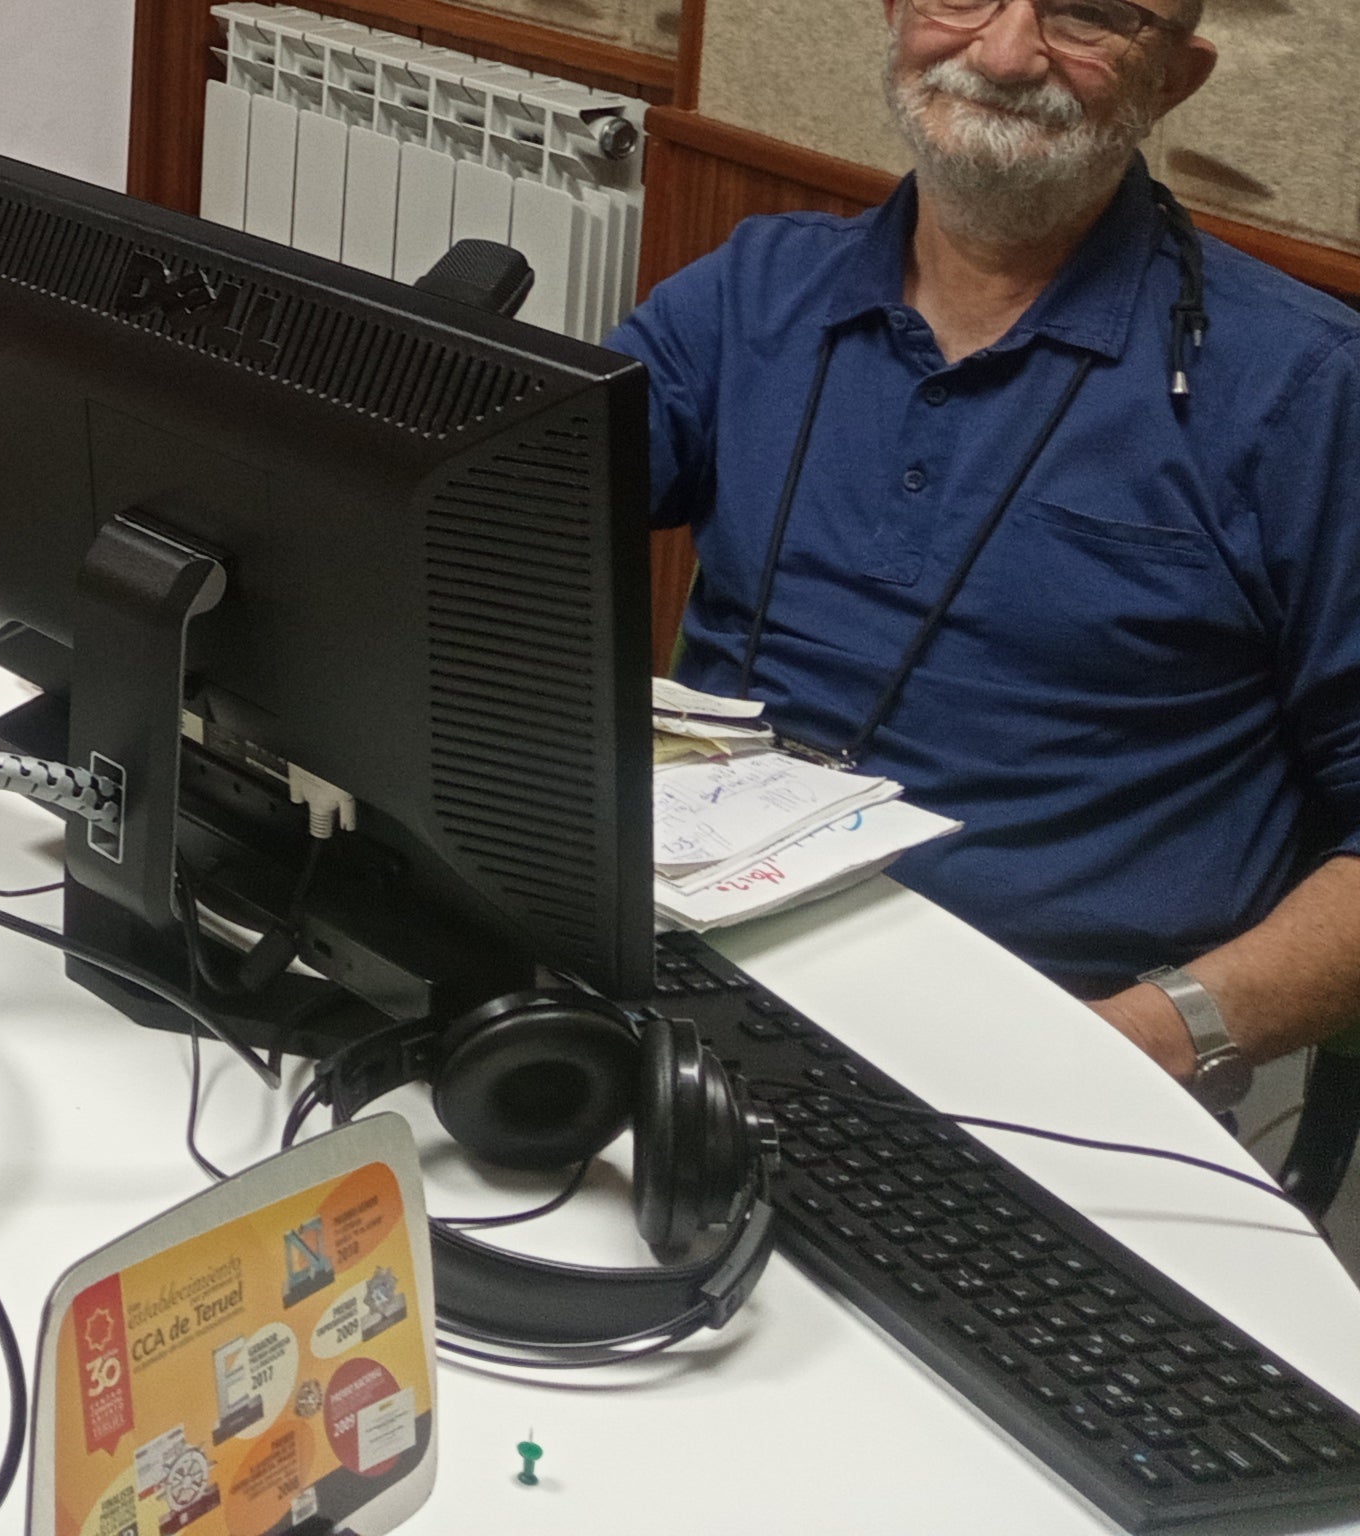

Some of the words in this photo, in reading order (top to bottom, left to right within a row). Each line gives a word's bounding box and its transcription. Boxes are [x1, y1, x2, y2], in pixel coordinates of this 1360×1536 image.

[131, 1328, 166, 1362] CCA
[169, 1314, 190, 1341] de
[194, 1279, 243, 1326] Teruel
[85, 1356, 122, 1397] 30
